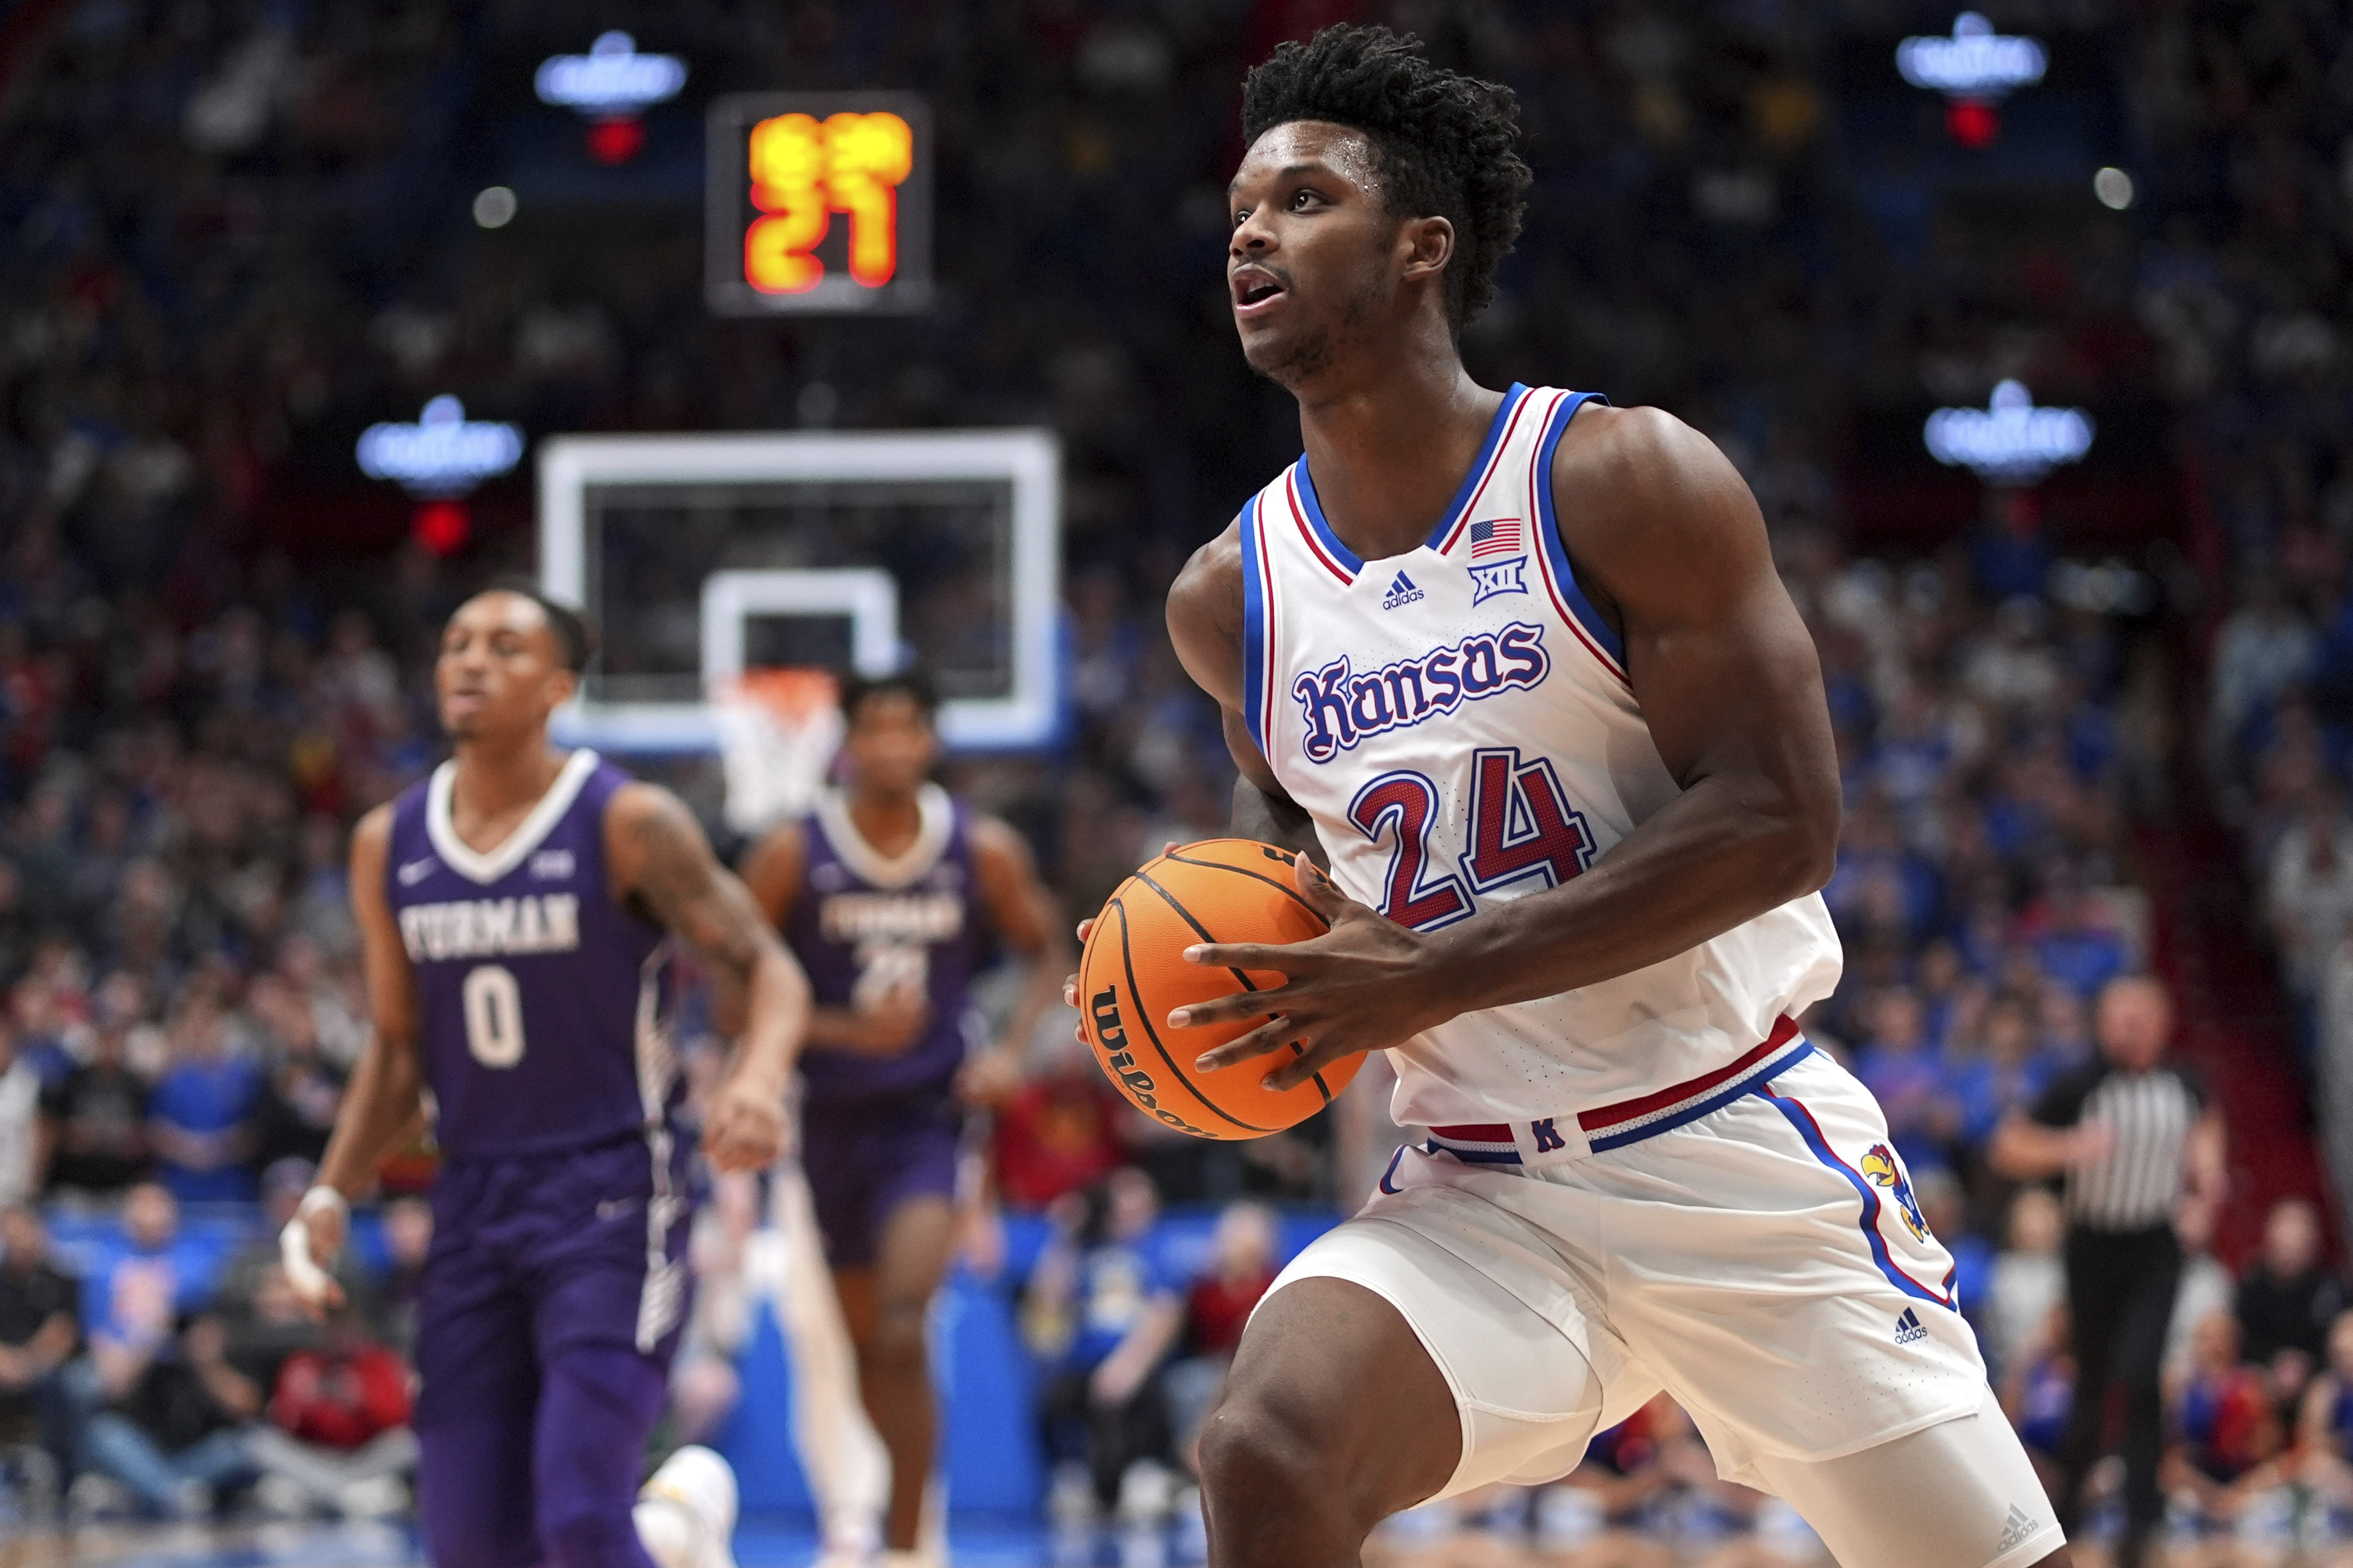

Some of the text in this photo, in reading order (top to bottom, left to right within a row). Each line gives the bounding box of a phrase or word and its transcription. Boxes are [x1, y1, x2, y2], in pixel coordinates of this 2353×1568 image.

[1382, 588, 1425, 610] adidas
[1292, 621, 1550, 764] Kansas
[1347, 747, 1597, 933] 24
[463, 964, 525, 1070] 0
[1092, 984, 1219, 1137] Wilson
[1531, 1118, 1566, 1153] K
[1895, 1326, 1928, 1345] addas
[1997, 1519, 2039, 1553] adidas
